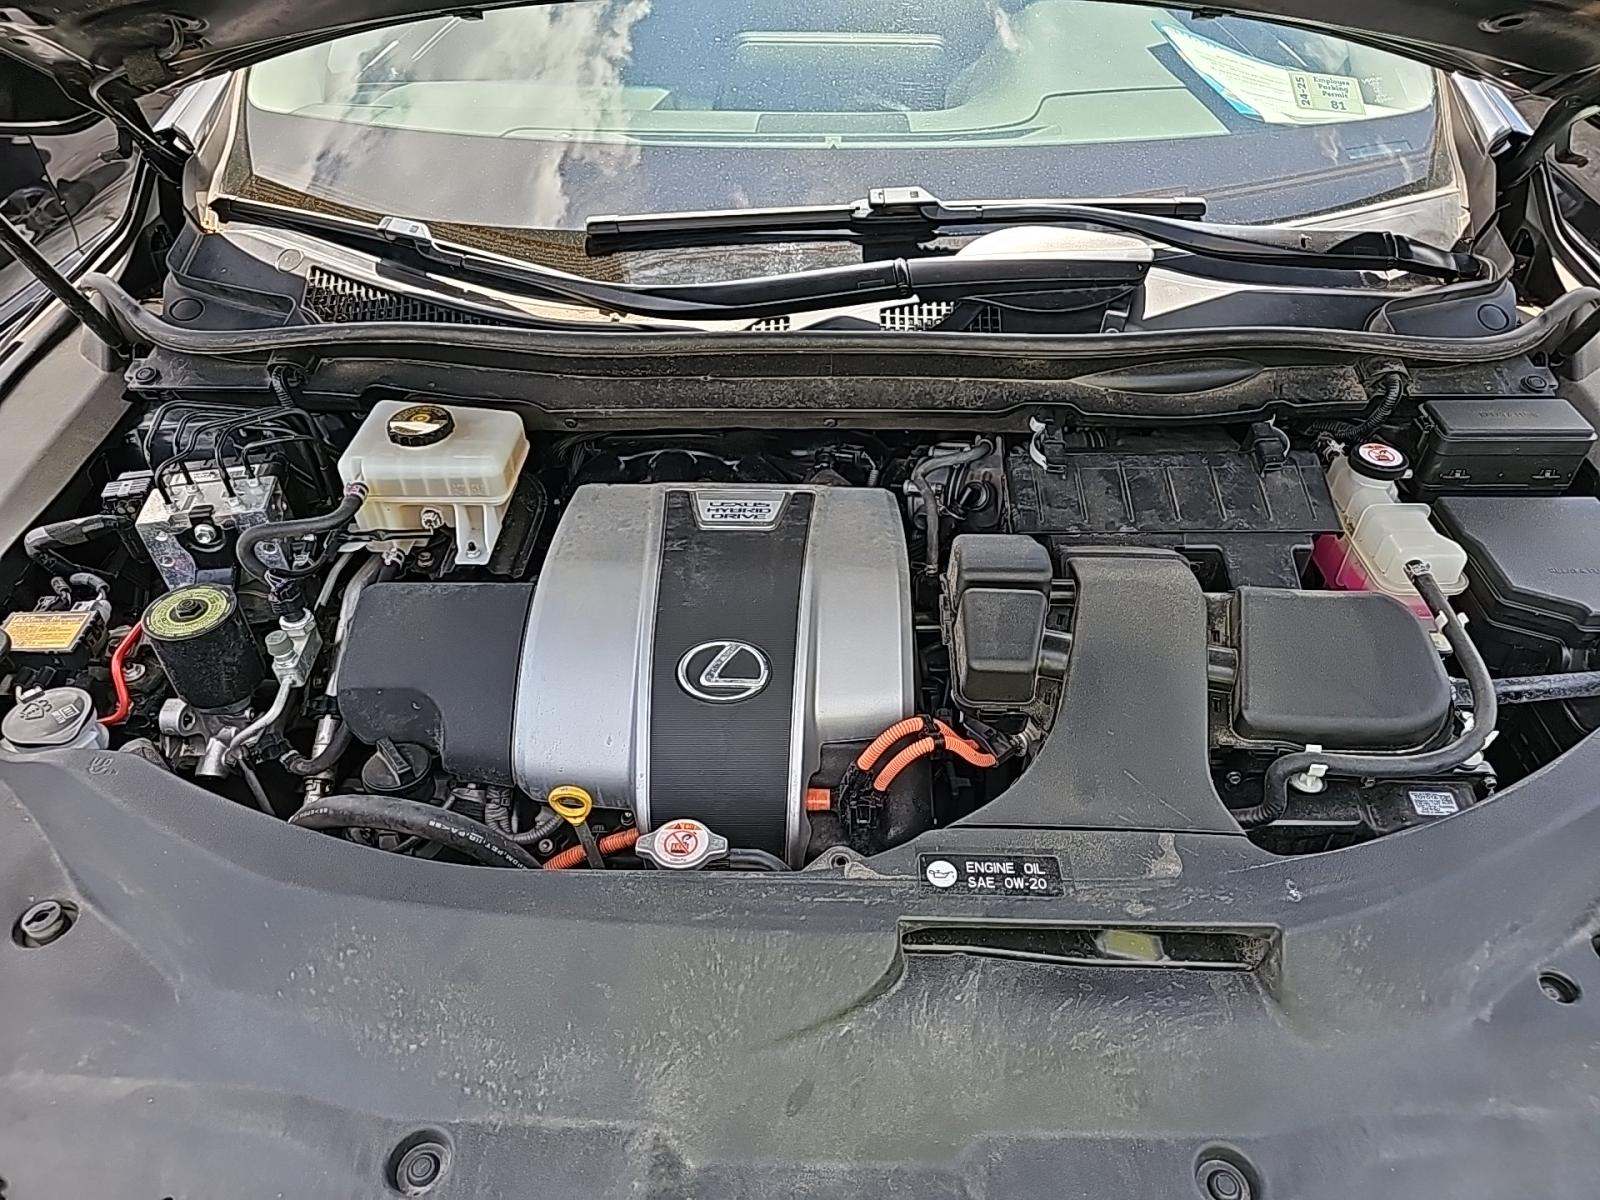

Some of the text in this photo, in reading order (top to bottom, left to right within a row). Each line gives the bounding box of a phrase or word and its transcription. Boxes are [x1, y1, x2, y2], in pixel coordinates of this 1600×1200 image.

[1313, 76, 1350, 86] Employee
[1295, 76, 1311, 106] 24-25
[1318, 83, 1349, 93] Parking
[1321, 90, 1348, 99] Permit
[1330, 100, 1347, 111] 81
[965, 861, 1046, 875] ENGINE OIL
[967, 877, 1048, 890] SAE 0W-20
